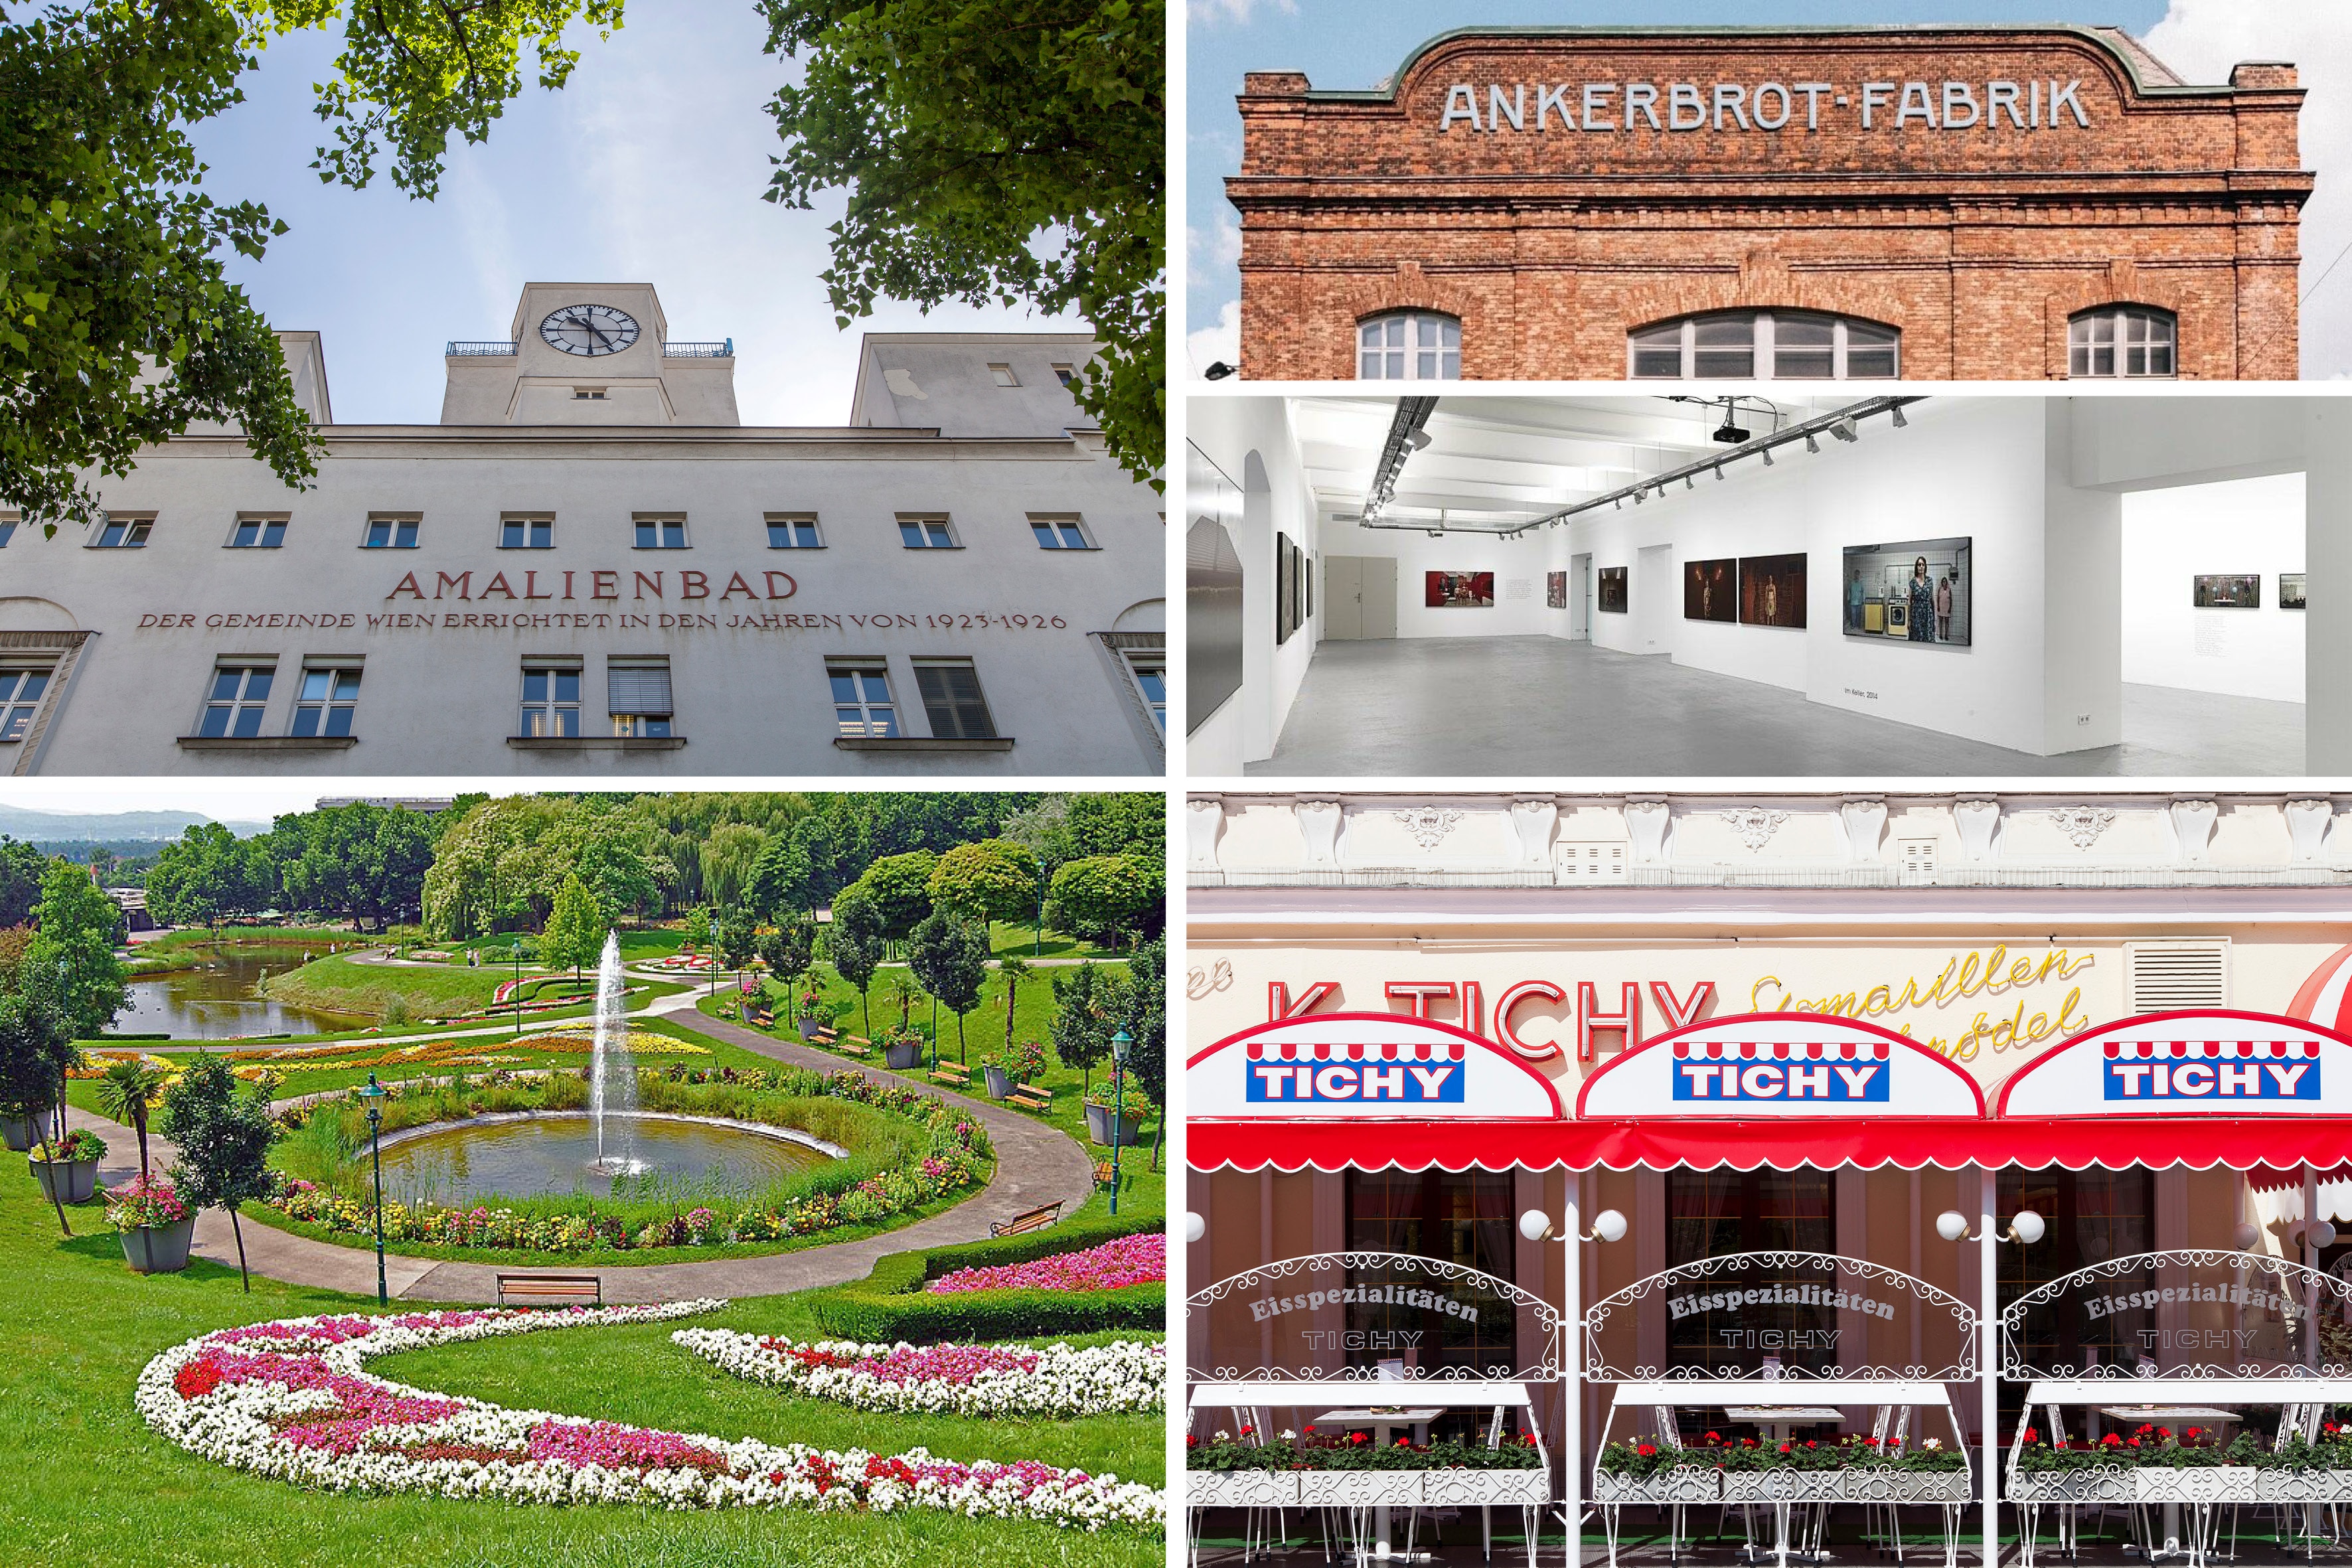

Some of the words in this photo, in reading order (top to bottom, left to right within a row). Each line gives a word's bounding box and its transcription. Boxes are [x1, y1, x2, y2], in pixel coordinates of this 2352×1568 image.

[386, 570, 799, 600] AMALIENBAD
[137, 613, 196, 628] DER
[205, 613, 356, 628] GEMEINDE
[365, 613, 435, 628] WIEN
[442, 613, 608, 628] ERRICHTET
[619, 613, 650, 628] IN
[658, 613, 717, 628] DEN
[726, 613, 842, 629] JAHREN
[848, 613, 917, 628] VON
[927, 613, 1067, 629] 1923-1926
[1385, 980, 1715, 1062] TICHY
[1254, 1065, 1457, 1100] TICHY
[1680, 1063, 1883, 1099] TICHY
[2111, 1063, 2313, 1097] TICHY
[1248, 1283, 1478, 1323] Eisspezialitäten
[1666, 1283, 1895, 1321] Eisspezialitäten
[2083, 1282, 2312, 1321] Eisspezialitäten
[1302, 1331, 1424, 1351] TICHY
[1721, 1329, 1843, 1350] TICHY
[2136, 1329, 2258, 1350] TICHY
